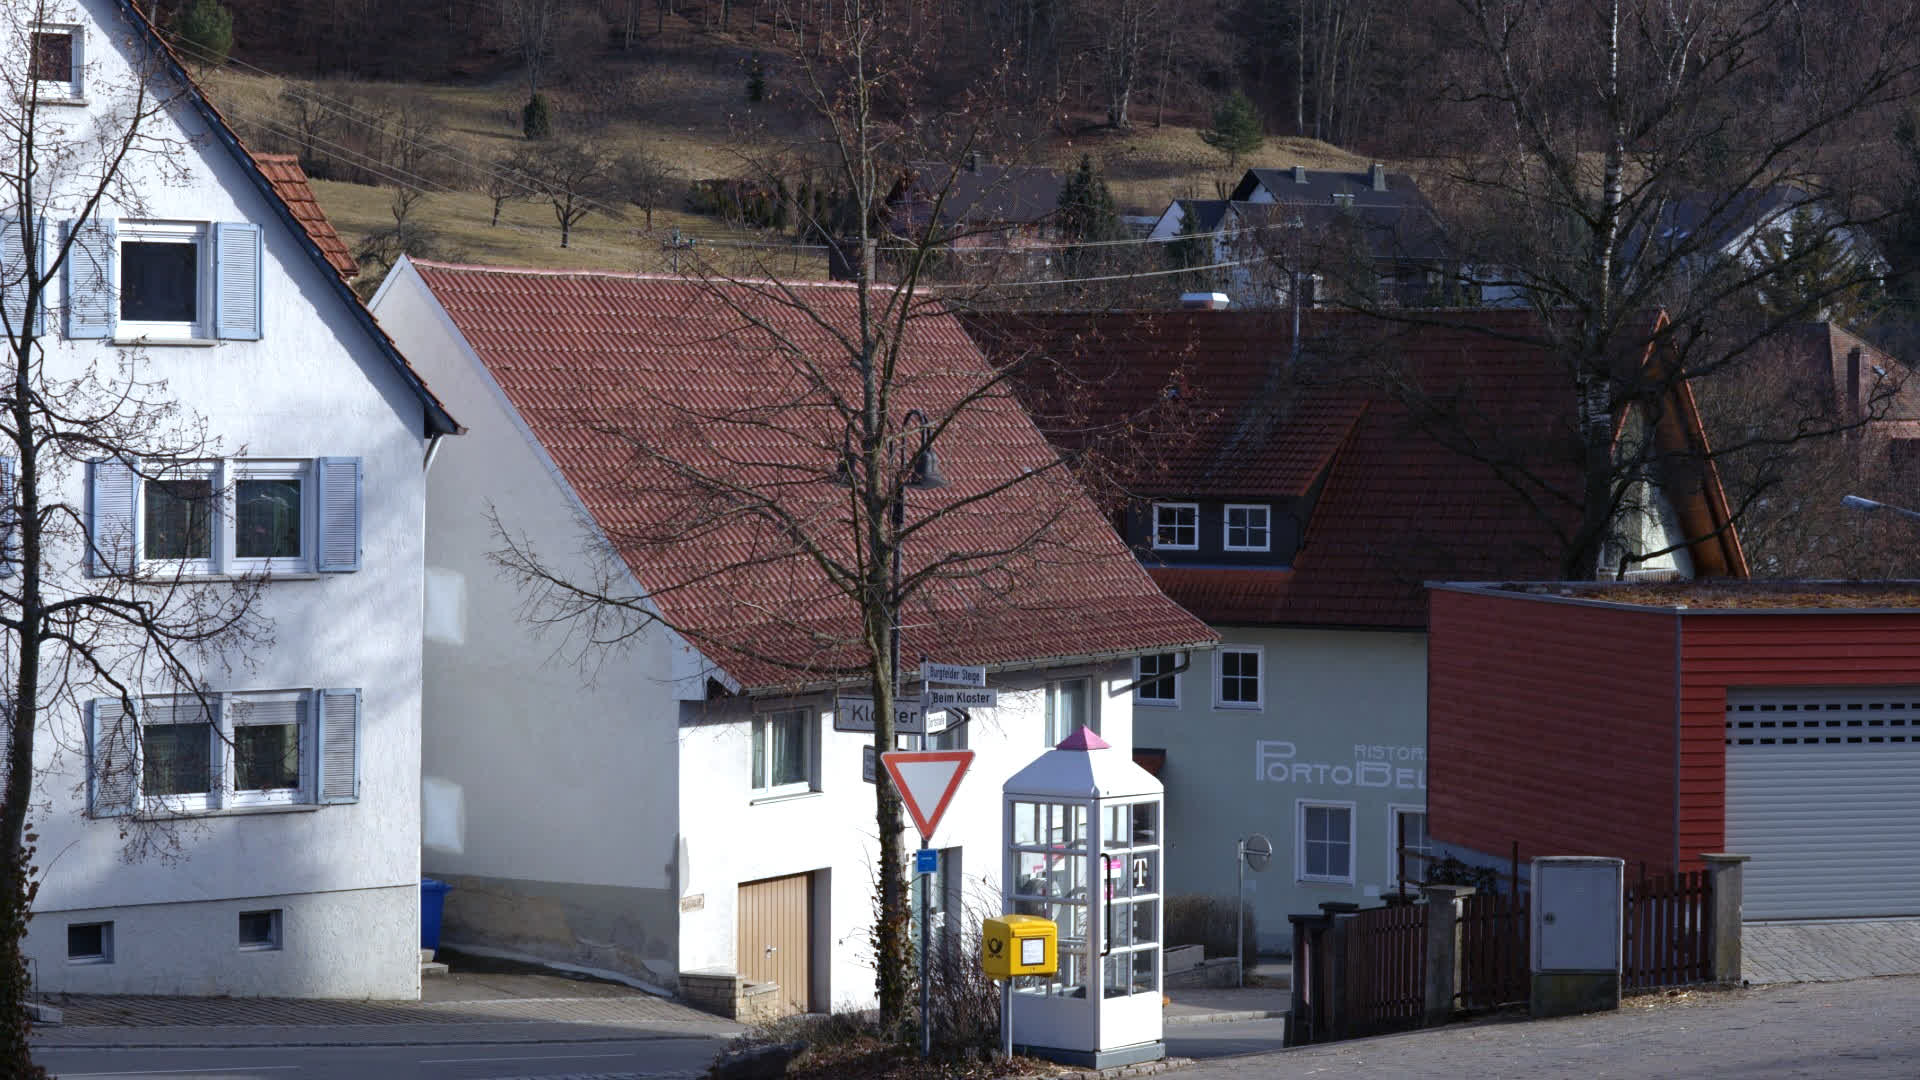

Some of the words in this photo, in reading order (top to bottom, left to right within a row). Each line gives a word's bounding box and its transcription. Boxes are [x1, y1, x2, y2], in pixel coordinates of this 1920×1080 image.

[961, 668, 980, 684] Steige
[933, 692, 954, 704] Beim
[957, 692, 990, 704] Kloster
[851, 704, 917, 724] Klter
[1354, 744, 1427, 761] RISTOR
[1133, 858, 1147, 887] T
